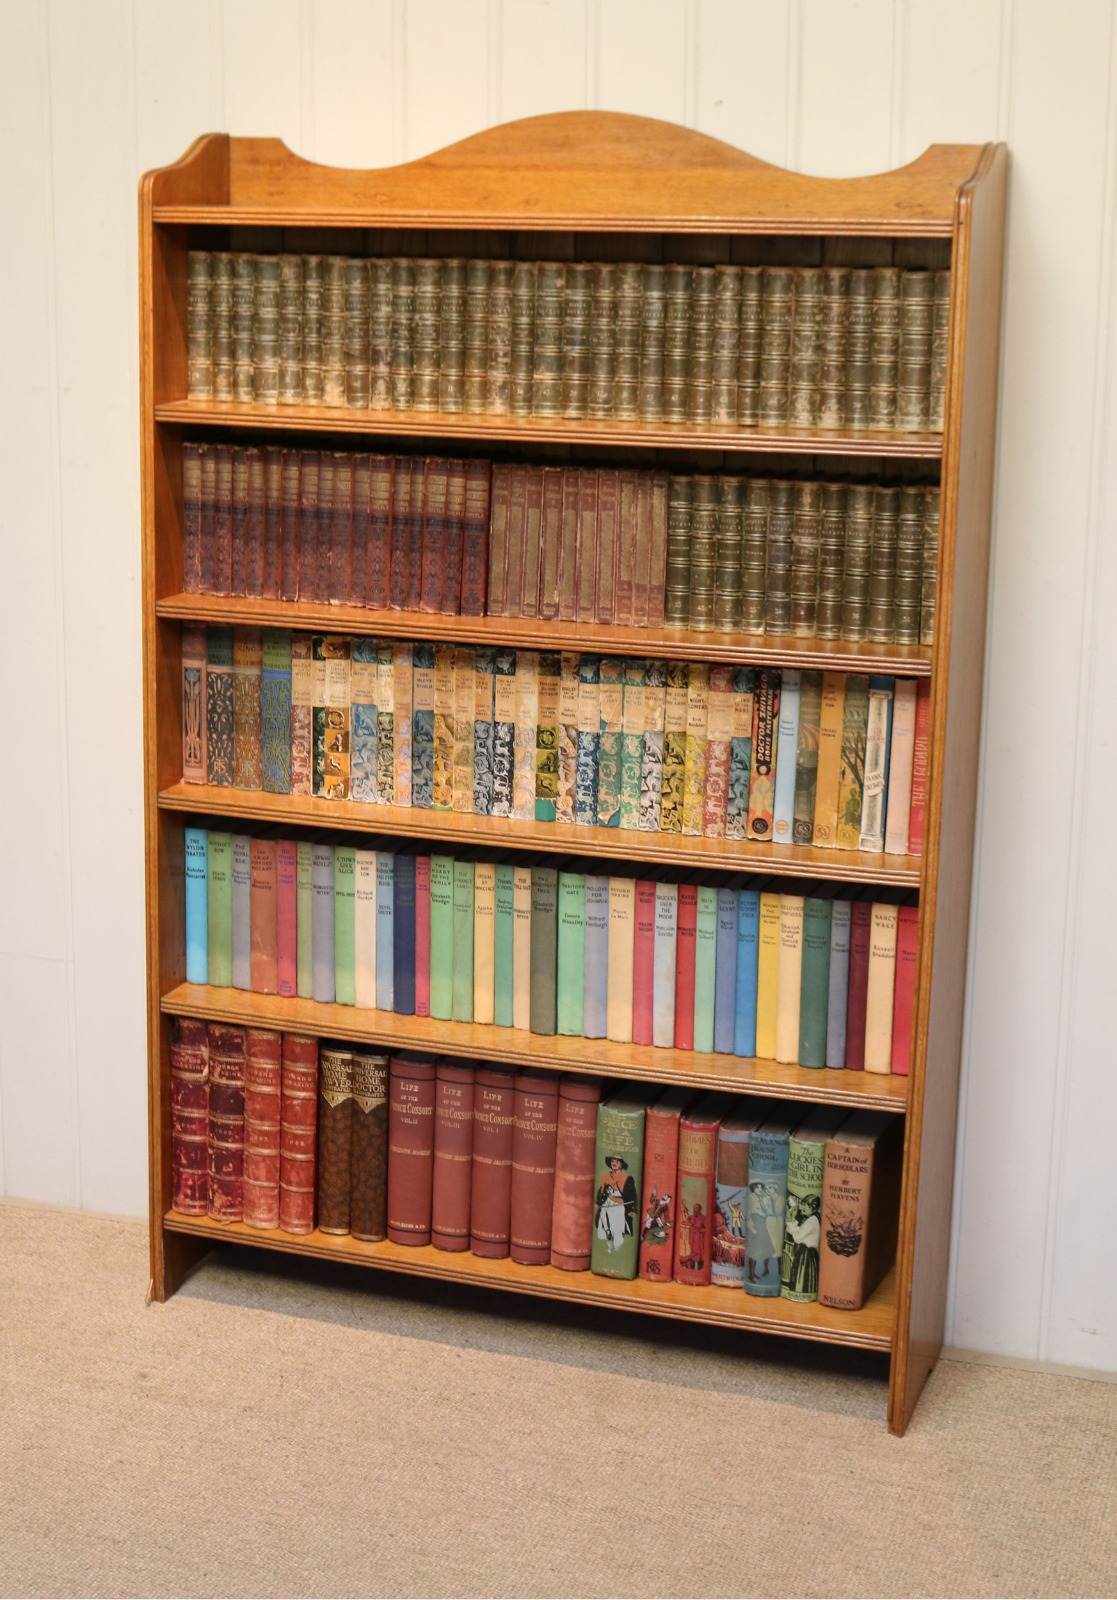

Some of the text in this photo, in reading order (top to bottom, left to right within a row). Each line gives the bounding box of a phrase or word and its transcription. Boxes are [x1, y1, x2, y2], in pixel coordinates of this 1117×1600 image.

[766, 688, 774, 733] PASTERNAK
[757, 674, 768, 761] DOCTOR ZHIVAGO
[912, 784, 925, 807] THE
[431, 892, 452, 900] Elizabeth
[656, 894, 677, 902] SAUCERS
[874, 913, 897, 922] NANCY
[656, 924, 676, 932] Malcolm
[875, 921, 895, 929] WAKE
[328, 1057, 342, 1065] THE
[361, 1062, 375, 1071] THE
[323, 1069, 347, 1080] HOME
[356, 1074, 381, 1085] HOME
[324, 1076, 353, 1088] AWYER
[353, 1081, 386, 1093] DOCTOR
[400, 1081, 420, 1092] LIFE
[443, 1086, 462, 1097] LIFE
[483, 1090, 503, 1102] LIFE
[524, 1097, 544, 1109] LIFE
[407, 1103, 433, 1116] CONSORT
[566, 1103, 585, 1115] LIFE
[531, 1119, 557, 1132] CONSORT
[622, 1129, 631, 1137] A
[603, 1133, 634, 1146] LIFE
[751, 1143, 776, 1154] HOUSE
[801, 1147, 814, 1156] The
[789, 1153, 823, 1165] LUCKIES
[827, 1153, 860, 1165] CAPTAIN
[790, 1161, 813, 1173] GIRL
[827, 1162, 868, 1174] IRREGULARS
[788, 1169, 799, 1179] THE
[829, 1184, 863, 1195] HERBERT
[830, 1192, 860, 1203] HAVENS
[823, 1294, 855, 1307] NELSON
